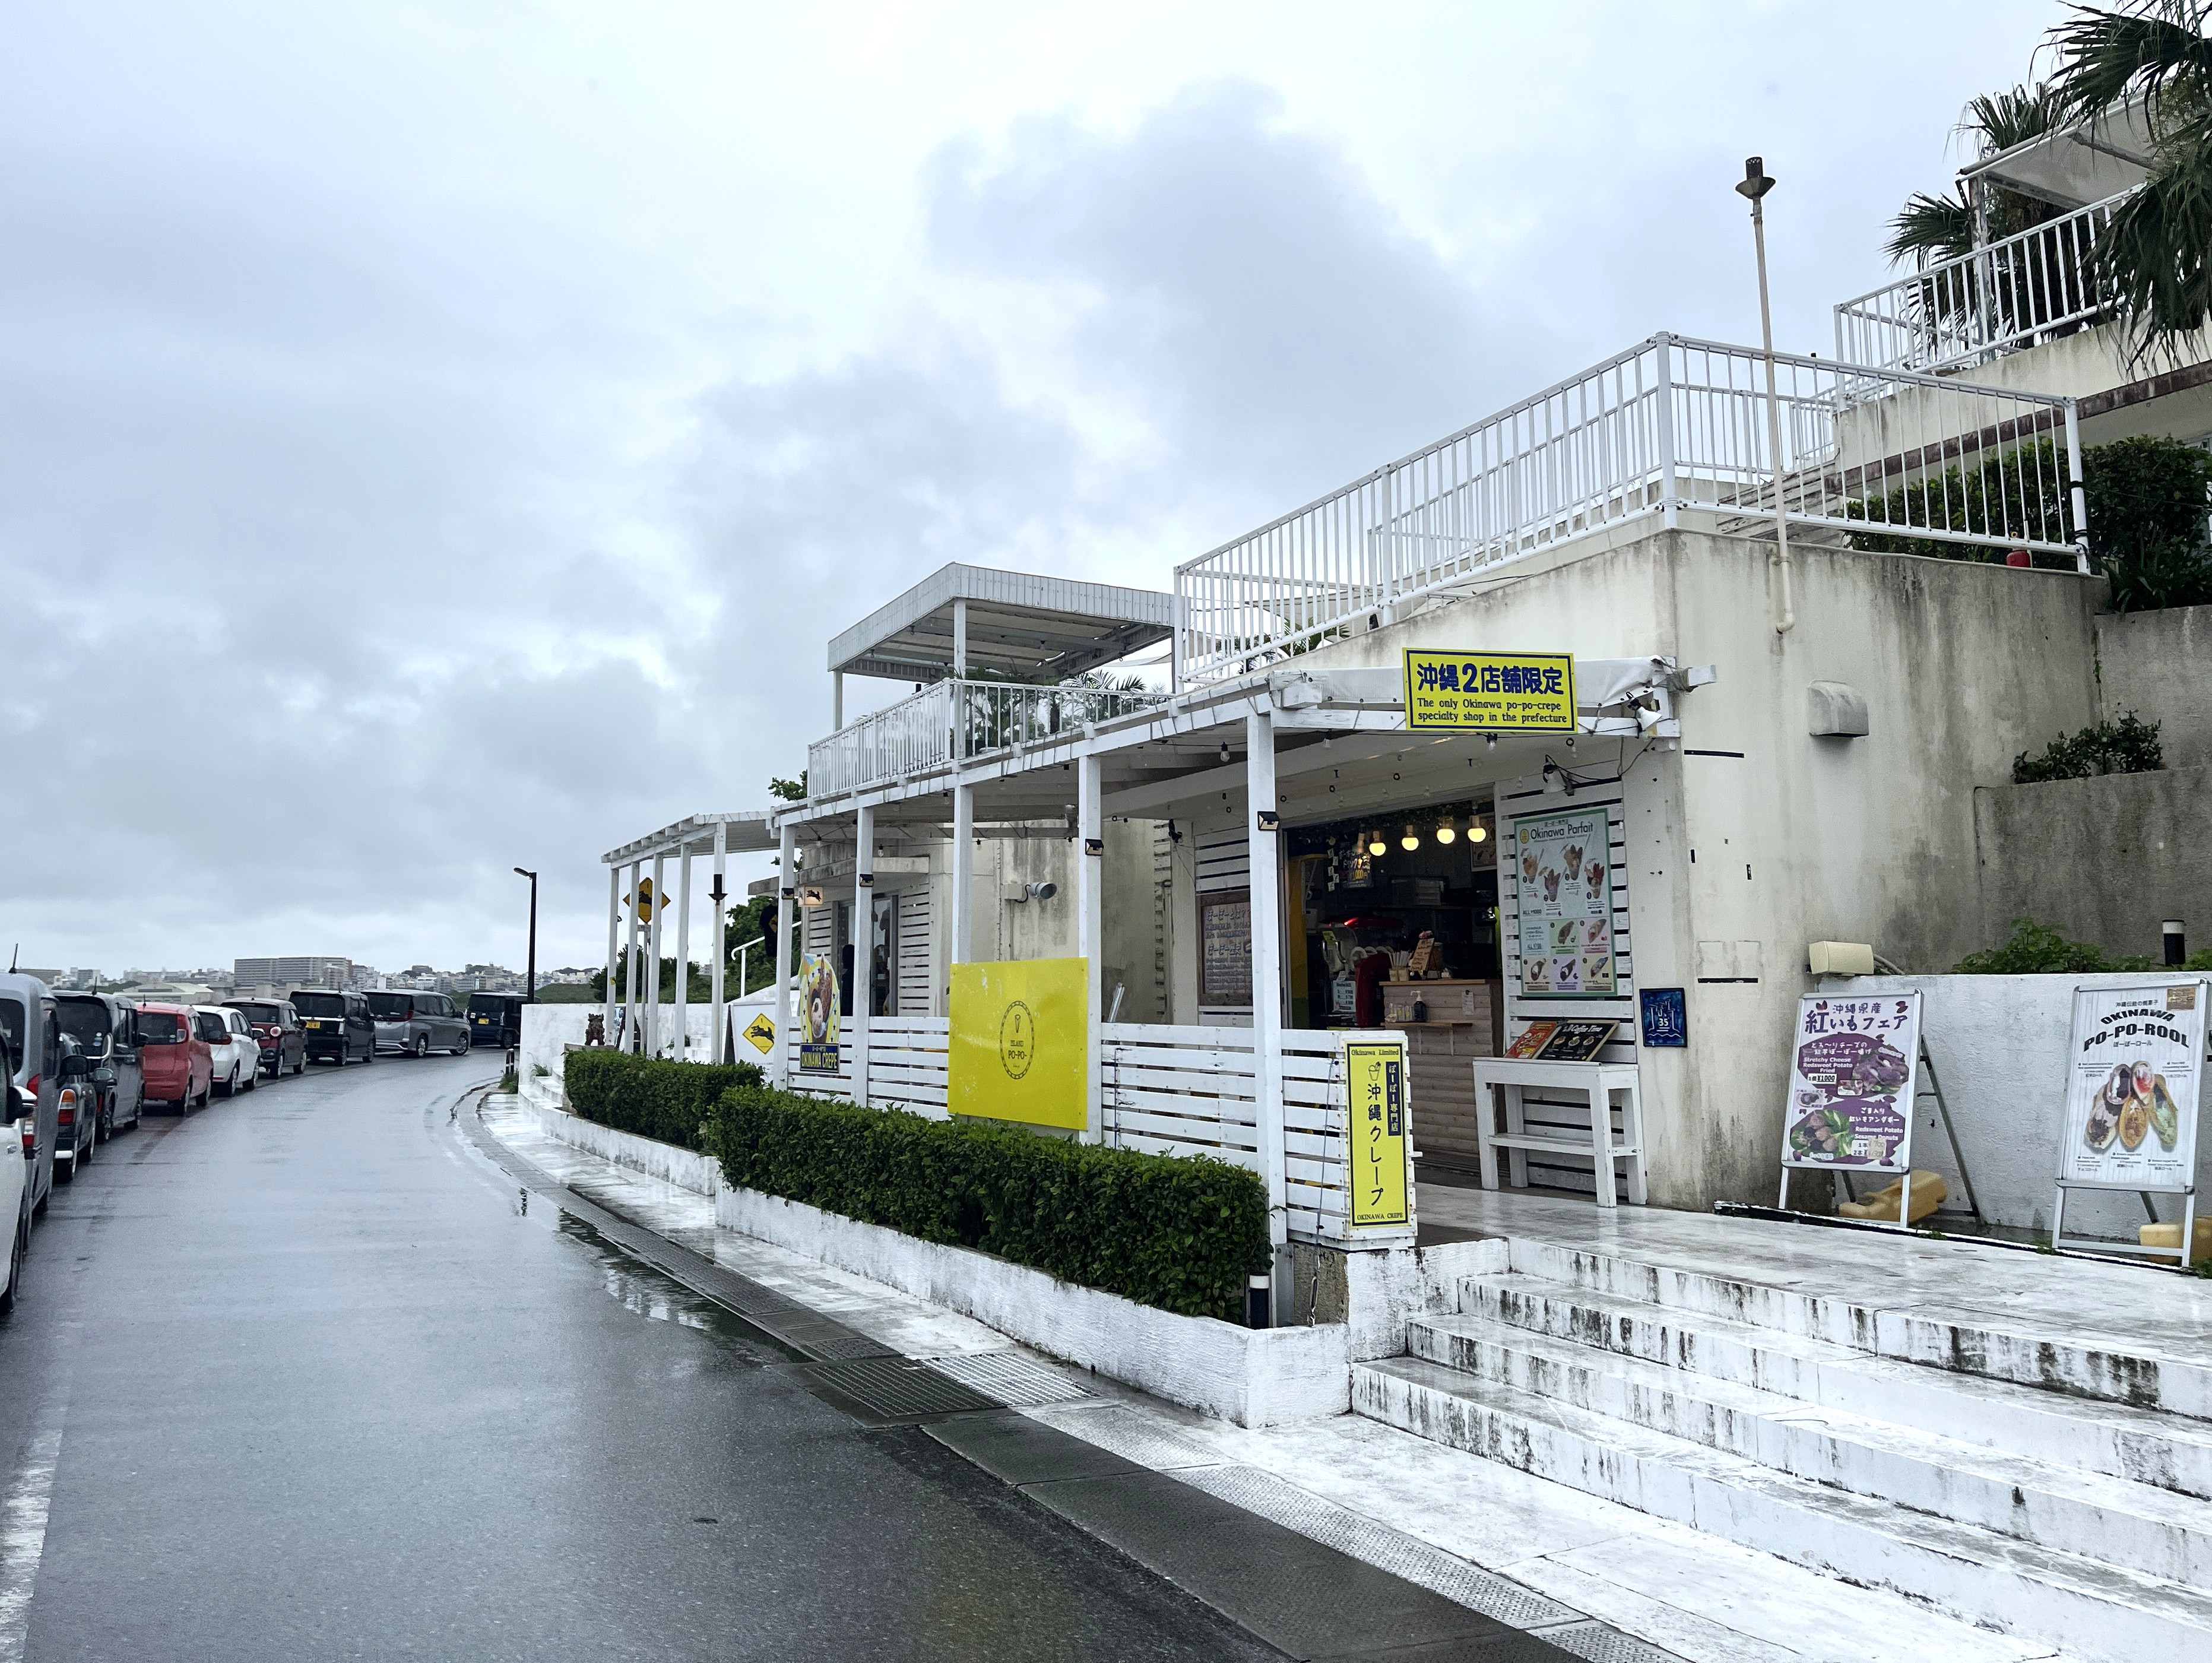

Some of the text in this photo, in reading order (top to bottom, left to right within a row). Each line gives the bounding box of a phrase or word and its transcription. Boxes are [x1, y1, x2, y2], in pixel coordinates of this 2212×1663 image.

[1417, 663, 1564, 695] 沖縄2店舗限定
[1417, 697, 1561, 710] The only Okinawa po-po-crepe
[1418, 711, 1567, 723] specialty shop in the prefecture
[1530, 826, 1564, 840] Okinawa
[1567, 821, 1593, 835] Parfait
[1833, 1002, 1881, 1014] 沖縄県産
[2100, 1008, 2175, 1025] OKINAWA
[1659, 1018, 1669, 1027] 35
[1805, 1010, 1908, 1034] 紅いもフェア
[2083, 1023, 2189, 1052] PO-PO-ROOL
[802, 1051, 837, 1069] OKINAWA CREPE
[1367, 1082, 1384, 1206] 沖縄クレープ
